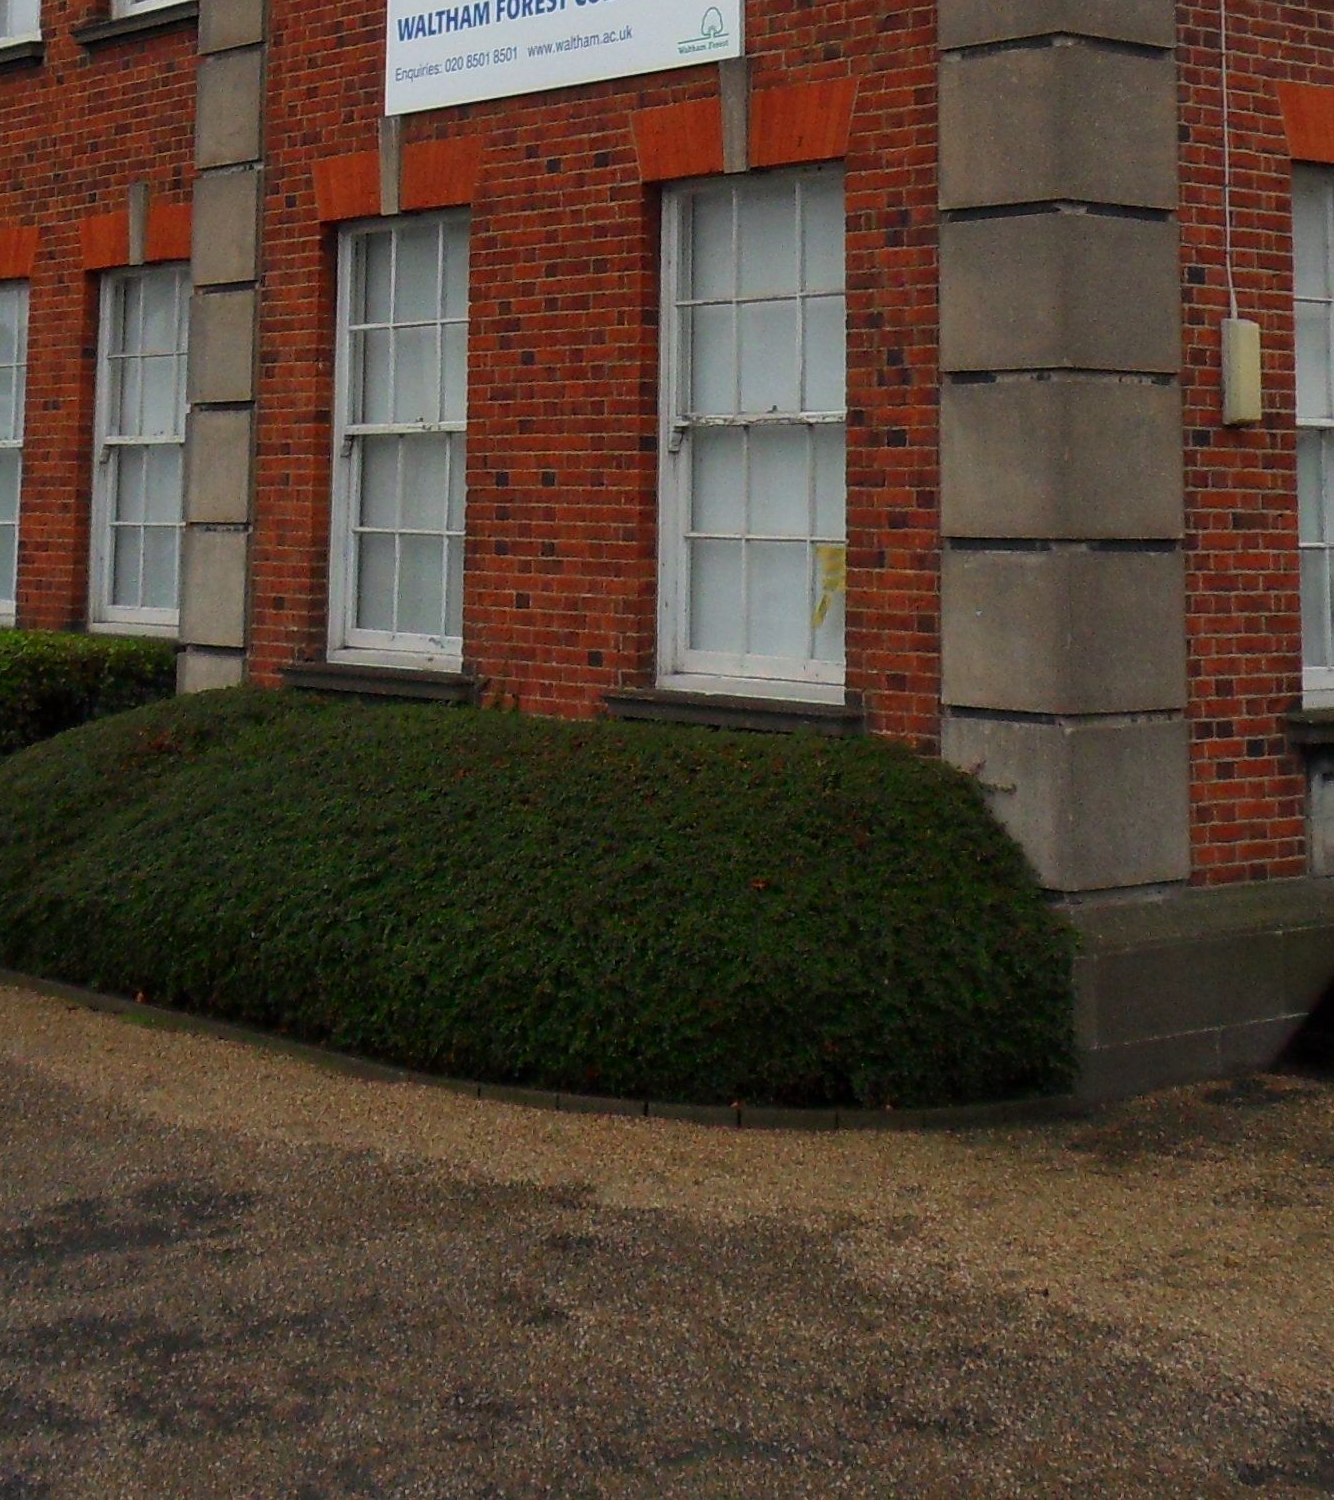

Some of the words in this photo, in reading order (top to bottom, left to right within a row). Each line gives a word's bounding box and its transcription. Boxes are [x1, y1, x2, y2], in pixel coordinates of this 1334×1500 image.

[397, 0, 491, 41] WALTHAM
[395, 62, 442, 83] Enquiries:
[444, 55, 464, 73] 020
[466, 51, 490, 69] 8501
[493, 46, 518, 65] 8501
[527, 25, 633, 58] www.waltham.ac.uk
